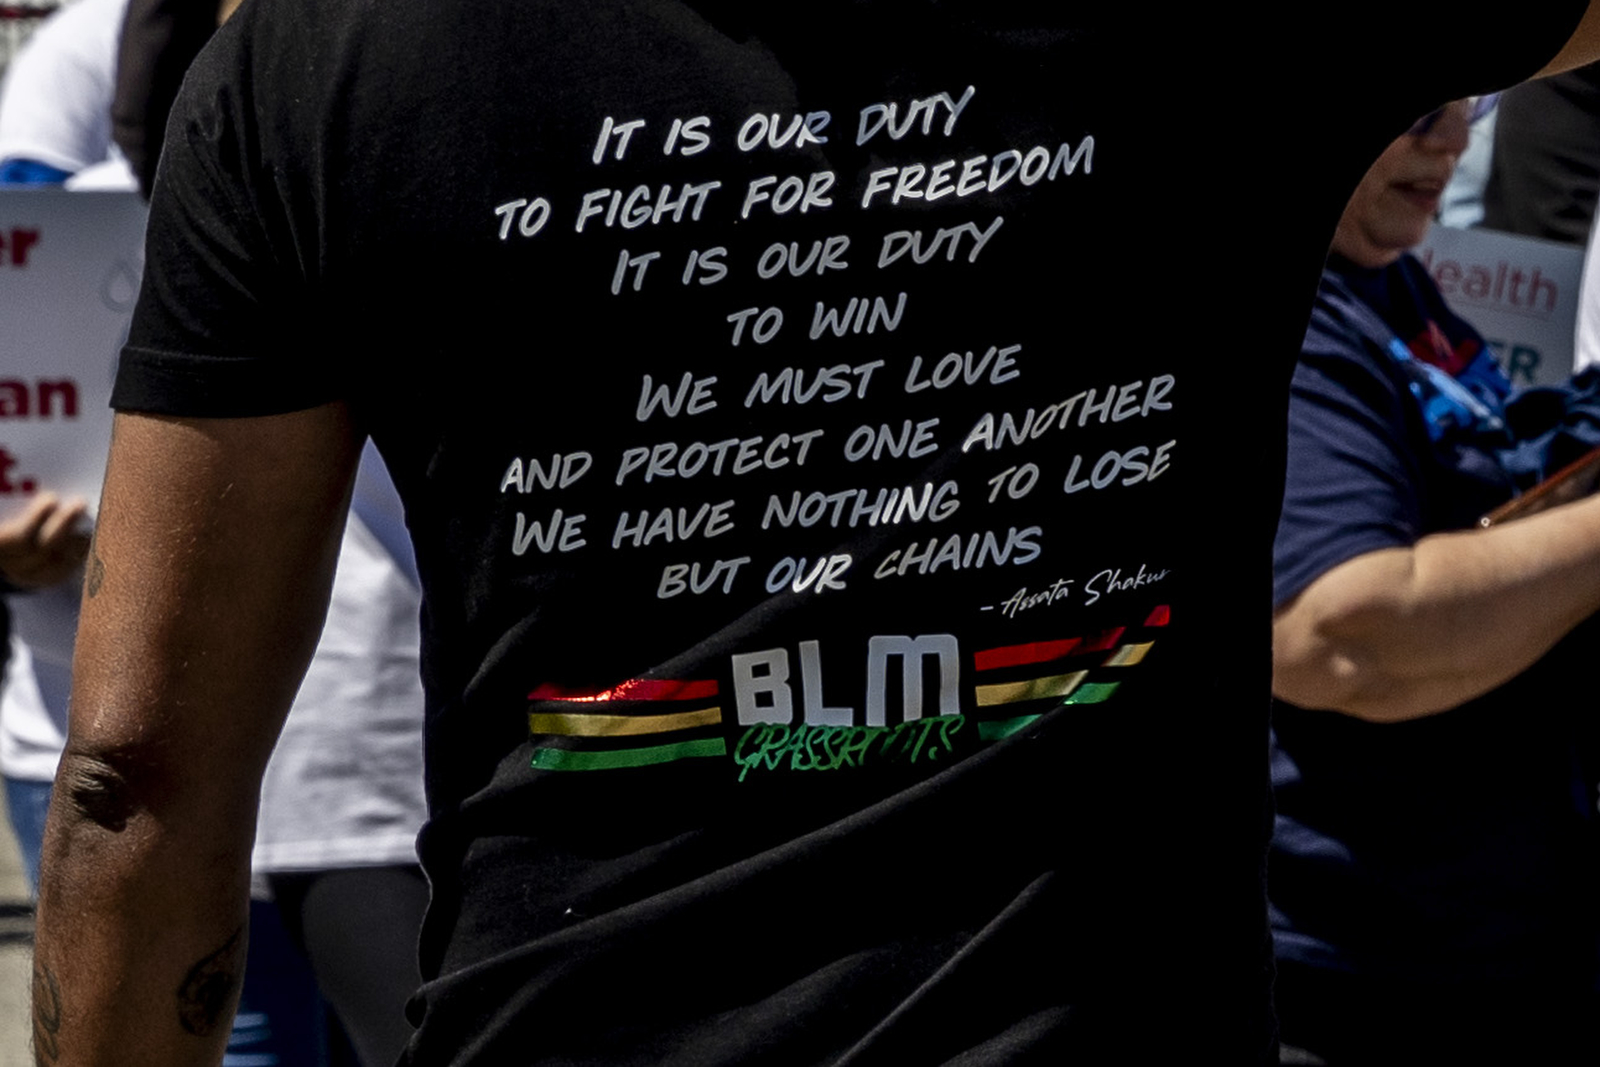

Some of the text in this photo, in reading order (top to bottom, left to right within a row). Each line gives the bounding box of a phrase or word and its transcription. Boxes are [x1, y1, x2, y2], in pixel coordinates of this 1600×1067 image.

[592, 84, 976, 165] IT IS OUR DUTY
[494, 135, 1095, 241] TO FIGHT FOR FREEDOM
[611, 215, 1004, 296] IT IS OUR DUTY
[726, 291, 908, 347] TO WIN
[636, 343, 1022, 422] WE MUST LOVE
[500, 374, 1176, 494] AND PROTECT ONE ANOTHER
[511, 439, 1177, 556] WE HAVE NOTHING TO LOSE
[657, 526, 1043, 599] BUT OUR CHAINS
[1001, 578, 1075, 619] Assata
[731, 633, 961, 727] BLM
